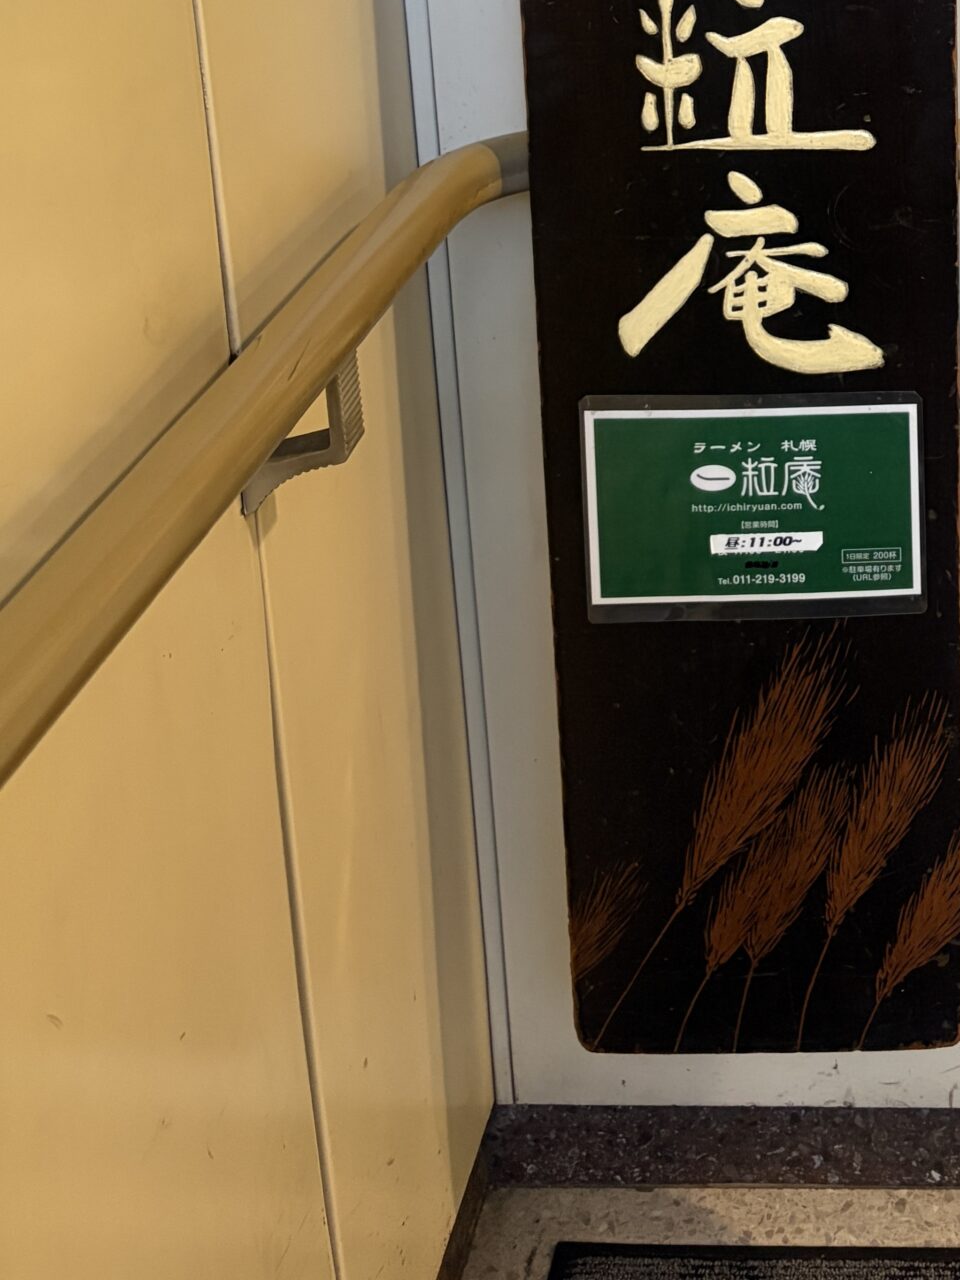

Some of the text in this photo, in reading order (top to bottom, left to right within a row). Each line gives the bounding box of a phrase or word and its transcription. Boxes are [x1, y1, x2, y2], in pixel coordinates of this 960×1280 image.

[693, 439, 817, 453] ラーメン 札幌
[690, 456, 825, 510] 一粒庵
[691, 502, 802, 513] http://ichiryuan.com
